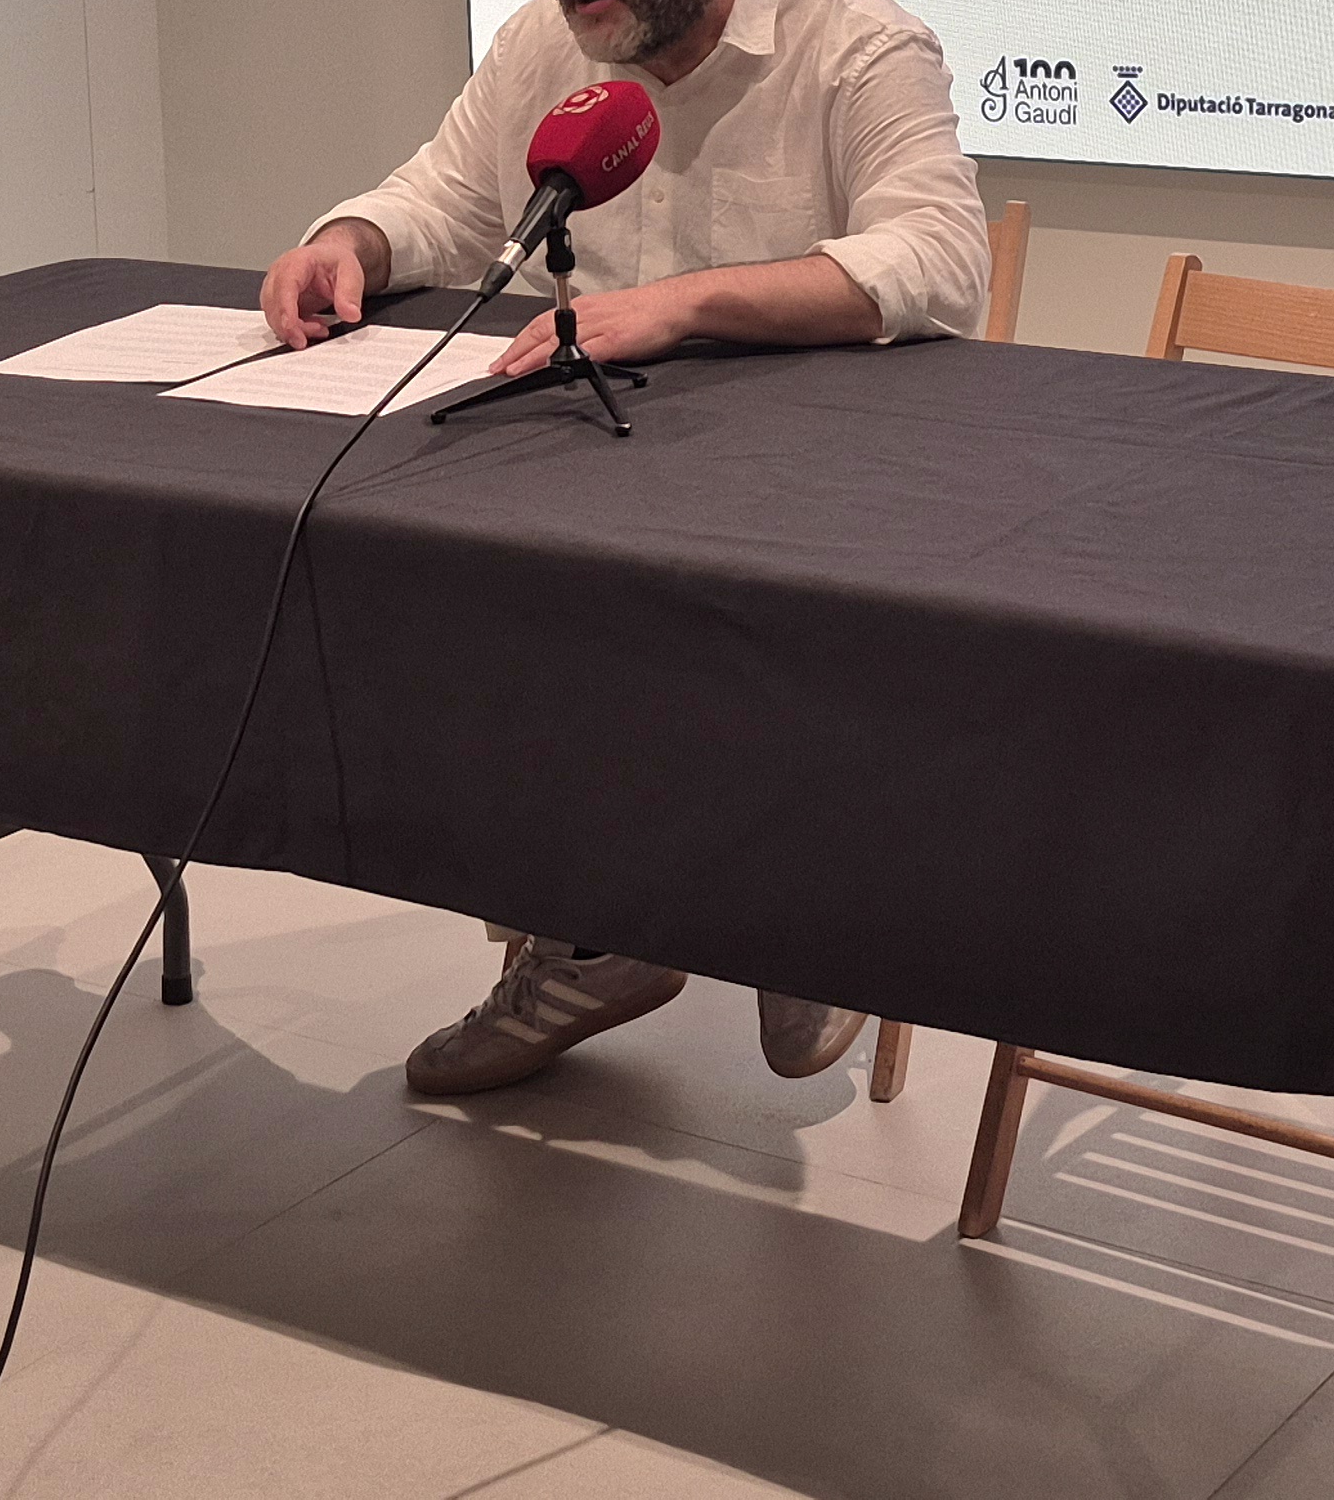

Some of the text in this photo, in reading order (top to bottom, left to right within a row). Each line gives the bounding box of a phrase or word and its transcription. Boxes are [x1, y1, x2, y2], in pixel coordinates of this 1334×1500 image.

[1014, 79, 1078, 101] Antoni
[1014, 101, 1077, 125] Gaudí
[1157, 92, 1242, 117] Diputació
